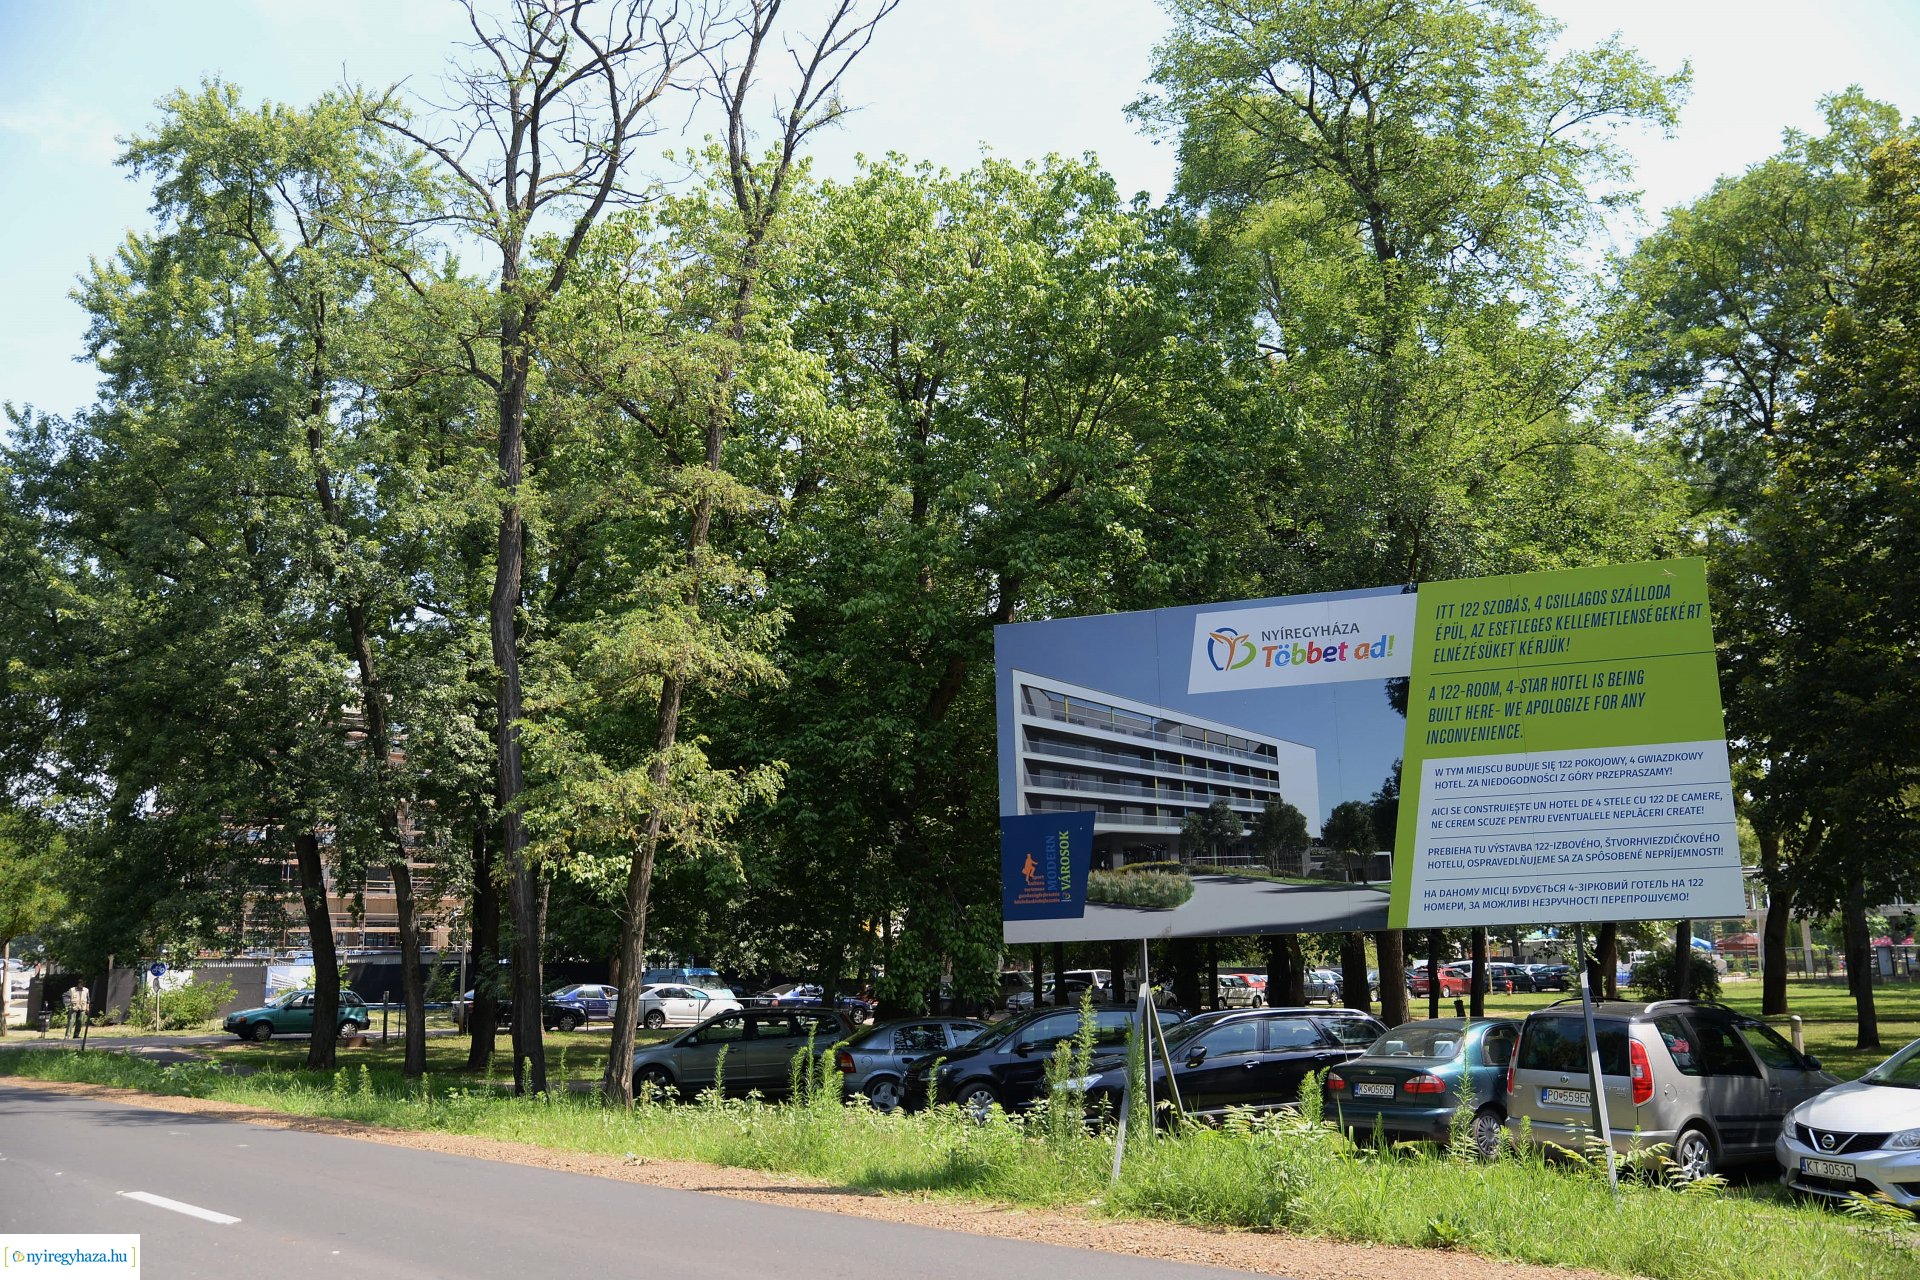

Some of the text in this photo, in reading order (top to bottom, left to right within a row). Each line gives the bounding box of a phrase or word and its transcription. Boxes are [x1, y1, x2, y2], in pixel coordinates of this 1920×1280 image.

[1436, 584, 1671, 619] ITT 122 SZOBÁS, 4 CSILLAGOS SZÁLLODA
[1261, 621, 1360, 642] NYÍREGYHÁZA
[1436, 601, 1703, 641] ÉPÜL, AZ ESETLEGES KELLEMETLENSÉGEKÉRT
[1262, 634, 1395, 668] Többet ad!
[1433, 635, 1570, 663] ELNÉZÉSÜKET KÉRJÜK!
[1428, 669, 1645, 701] A 122-ROOM, 4-STAR HOTEL IS BEING
[1428, 706, 1462, 723] BUILT
[1504, 701, 1523, 717] WE
[1525, 696, 1591, 715] APOLOGIZE
[1593, 694, 1618, 711] FOR
[1621, 692, 1646, 709] ANY
[1426, 723, 1523, 745] INCONVENIENCE.
[1434, 751, 1704, 777] W TYM MIEJSCU BUDUJE SIĘ 122 POKOJOWY, 4 GWIAZDKOWY
[1434, 767, 1673, 789] HOTEL. ZA NIEDOGODNOŚCI Z GÓRY PRZEPRASZAMY!
[1431, 807, 1448, 816] AICI
[1450, 806, 1461, 815] SE
[1533, 801, 1547, 810] UN
[1549, 799, 1579, 809] HOTEL
[1581, 799, 1593, 808] DE
[1595, 798, 1601, 807] 4
[1603, 796, 1631, 807] STELE
[1633, 795, 1646, 805] CU
[1648, 794, 1664, 804] 122
[1666, 793, 1679, 803] DE
[1681, 791, 1723, 802] CAMERE,
[1431, 820, 1443, 829] NE
[1445, 818, 1475, 828] CEREM
[1477, 817, 1506, 827] SCUZE
[1508, 815, 1545, 825] PENTRU
[1547, 811, 1610, 823] EVENTUALELE
[1666, 806, 1705, 816] CREATE!
[1428, 832, 1720, 856] PREBIEHA TU VÝSTAVBA 122-IZBOVÉHO, ŠTVORHVIEZDIČKOVÉHO
[1045, 835, 1057, 891] MODERN
[1058, 830, 1072, 891] VÁROSOK
[1427, 847, 1724, 869] HOTELU, OSPRAVEDLŇUJEME SA ZA SPÔSOBENÉ NEPRÍJEMNOSTI!
[1687, 878, 1704, 887] 122
